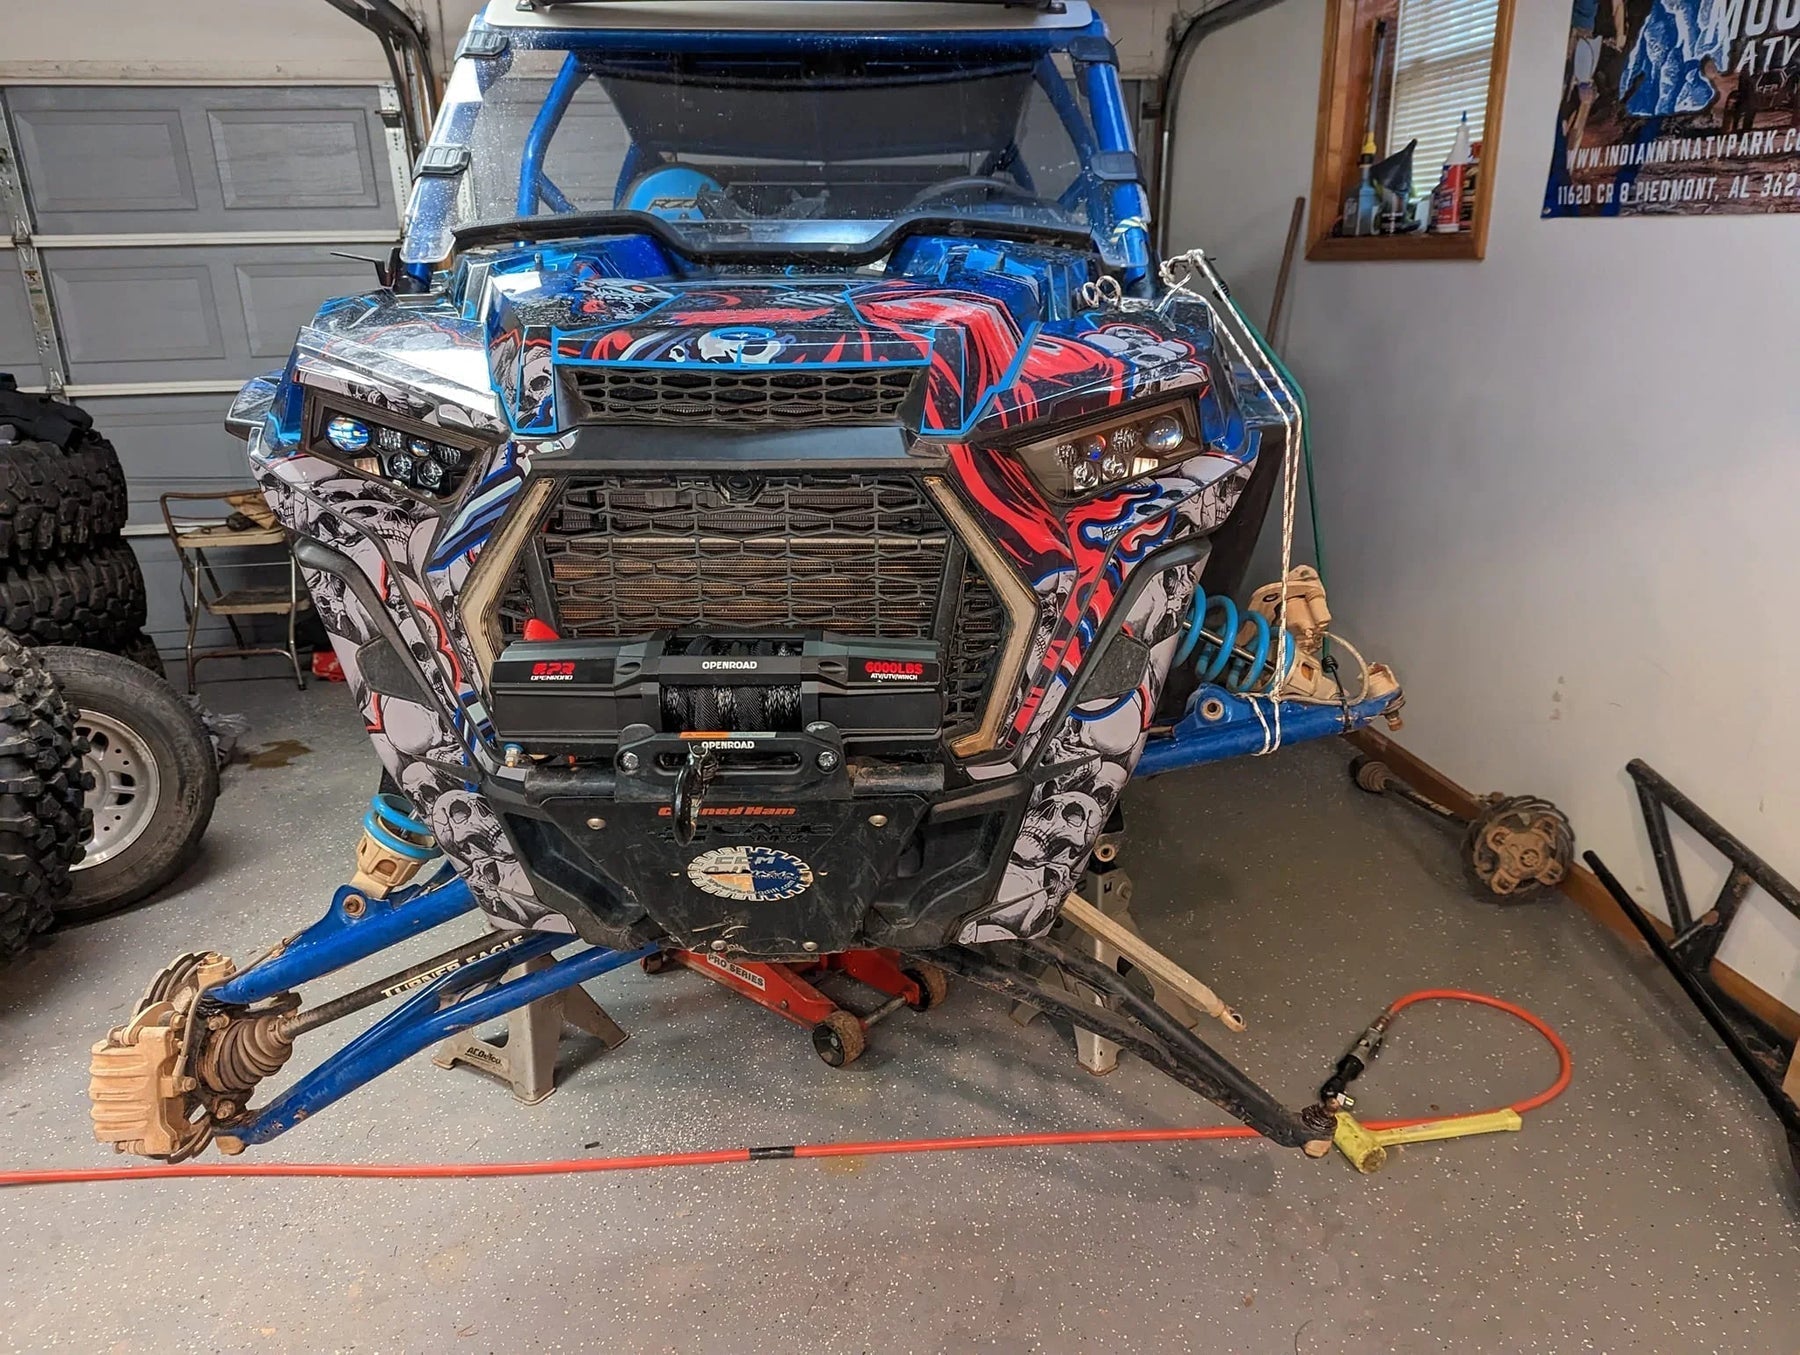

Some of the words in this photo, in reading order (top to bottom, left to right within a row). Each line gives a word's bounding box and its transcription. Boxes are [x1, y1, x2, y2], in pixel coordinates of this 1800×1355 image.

[1735, 36, 1800, 76] ATV
[1558, 185, 1591, 205] 11620
[1597, 183, 1614, 204] CR
[1620, 182, 1630, 202] 8
[1636, 176, 1719, 202] PIEDMONT,
[1728, 175, 1750, 198] AL
[1761, 172, 1800, 197] 362
[702, 661, 757, 669] OPENROAD
[865, 661, 923, 674] 6000LBS
[701, 741, 755, 749] OPENROAD
[744, 806, 796, 816] Ham
[708, 954, 727, 968] PRO
[730, 963, 764, 987] SERIES
